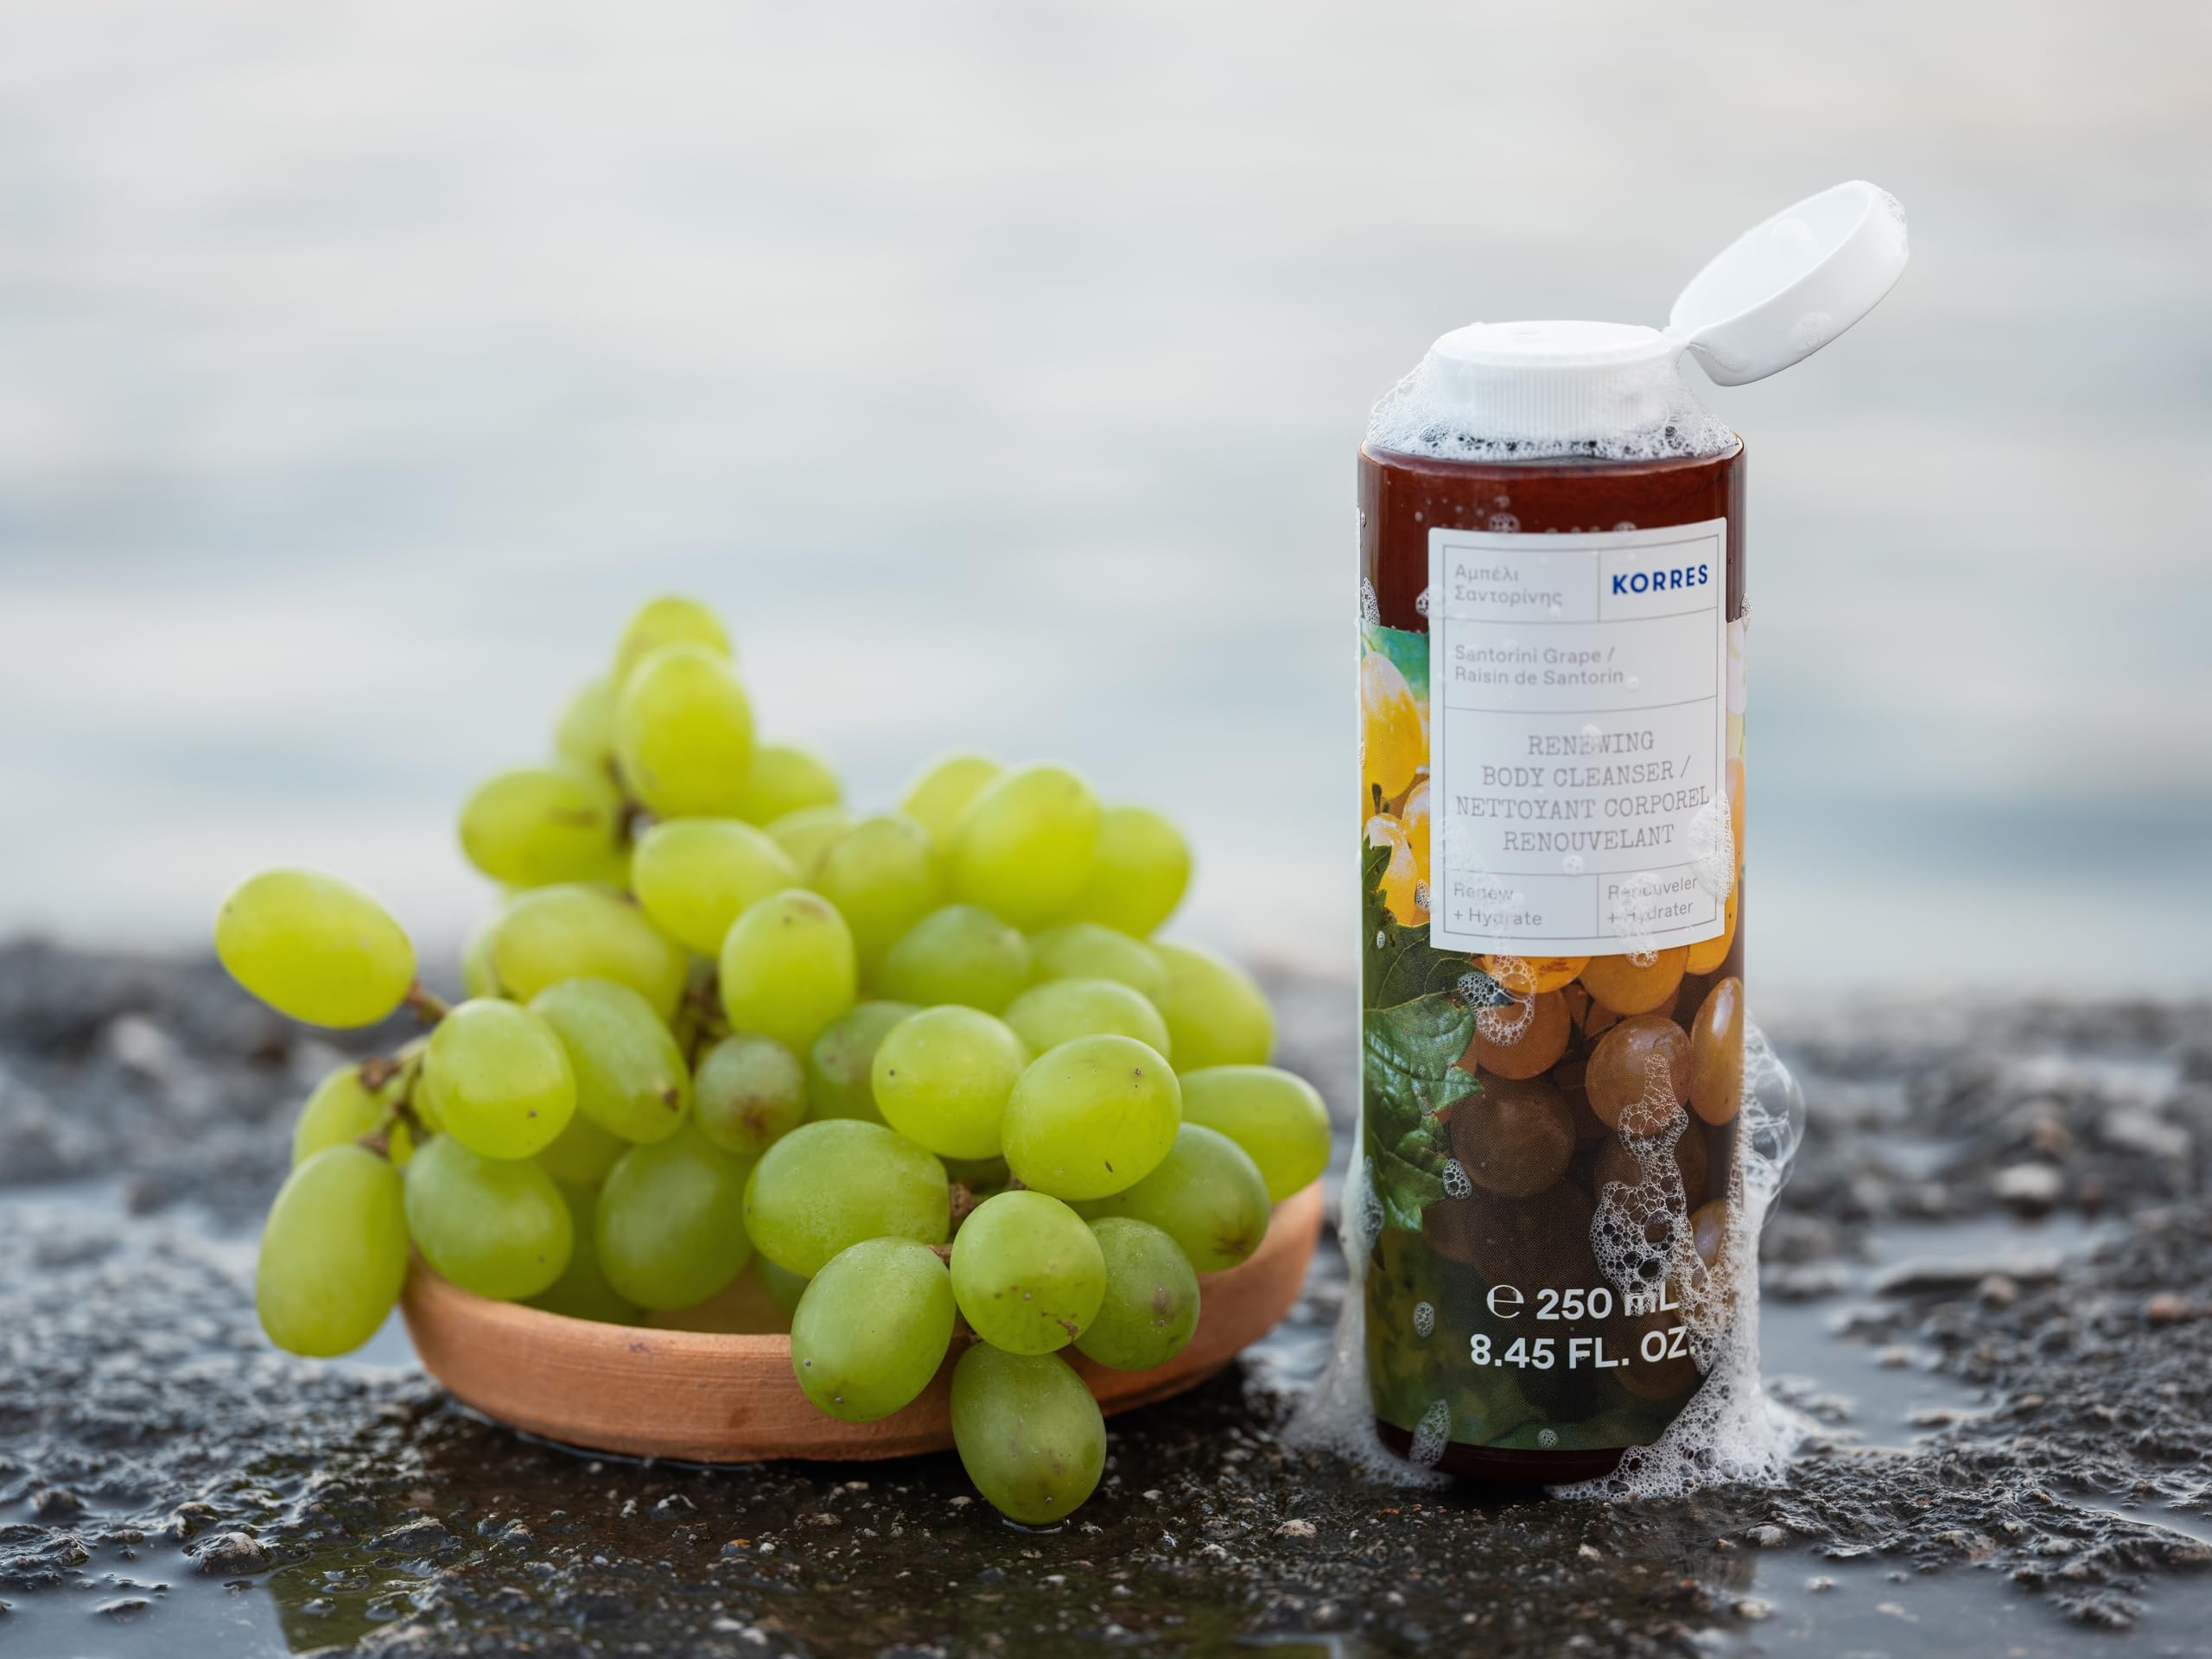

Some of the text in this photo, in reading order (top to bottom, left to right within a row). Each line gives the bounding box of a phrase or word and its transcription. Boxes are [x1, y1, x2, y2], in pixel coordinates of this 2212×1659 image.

[1612, 564, 1708, 595] KORRES
[1454, 645, 1537, 665] Santorini
[1544, 647, 1601, 667] Grape
[1454, 666, 1624, 685] Raisin de Santorin
[1482, 766, 1545, 788] BODY
[1553, 760, 1674, 787] CLEANSER
[1455, 785, 1710, 820] NETTOYANT CORPOREL
[1503, 823, 1675, 852] RENOUVELANT
[1536, 1287, 1612, 1320] 250
[1470, 1333, 1554, 1369] 8.45
[1569, 1337, 1630, 1369] FL.
